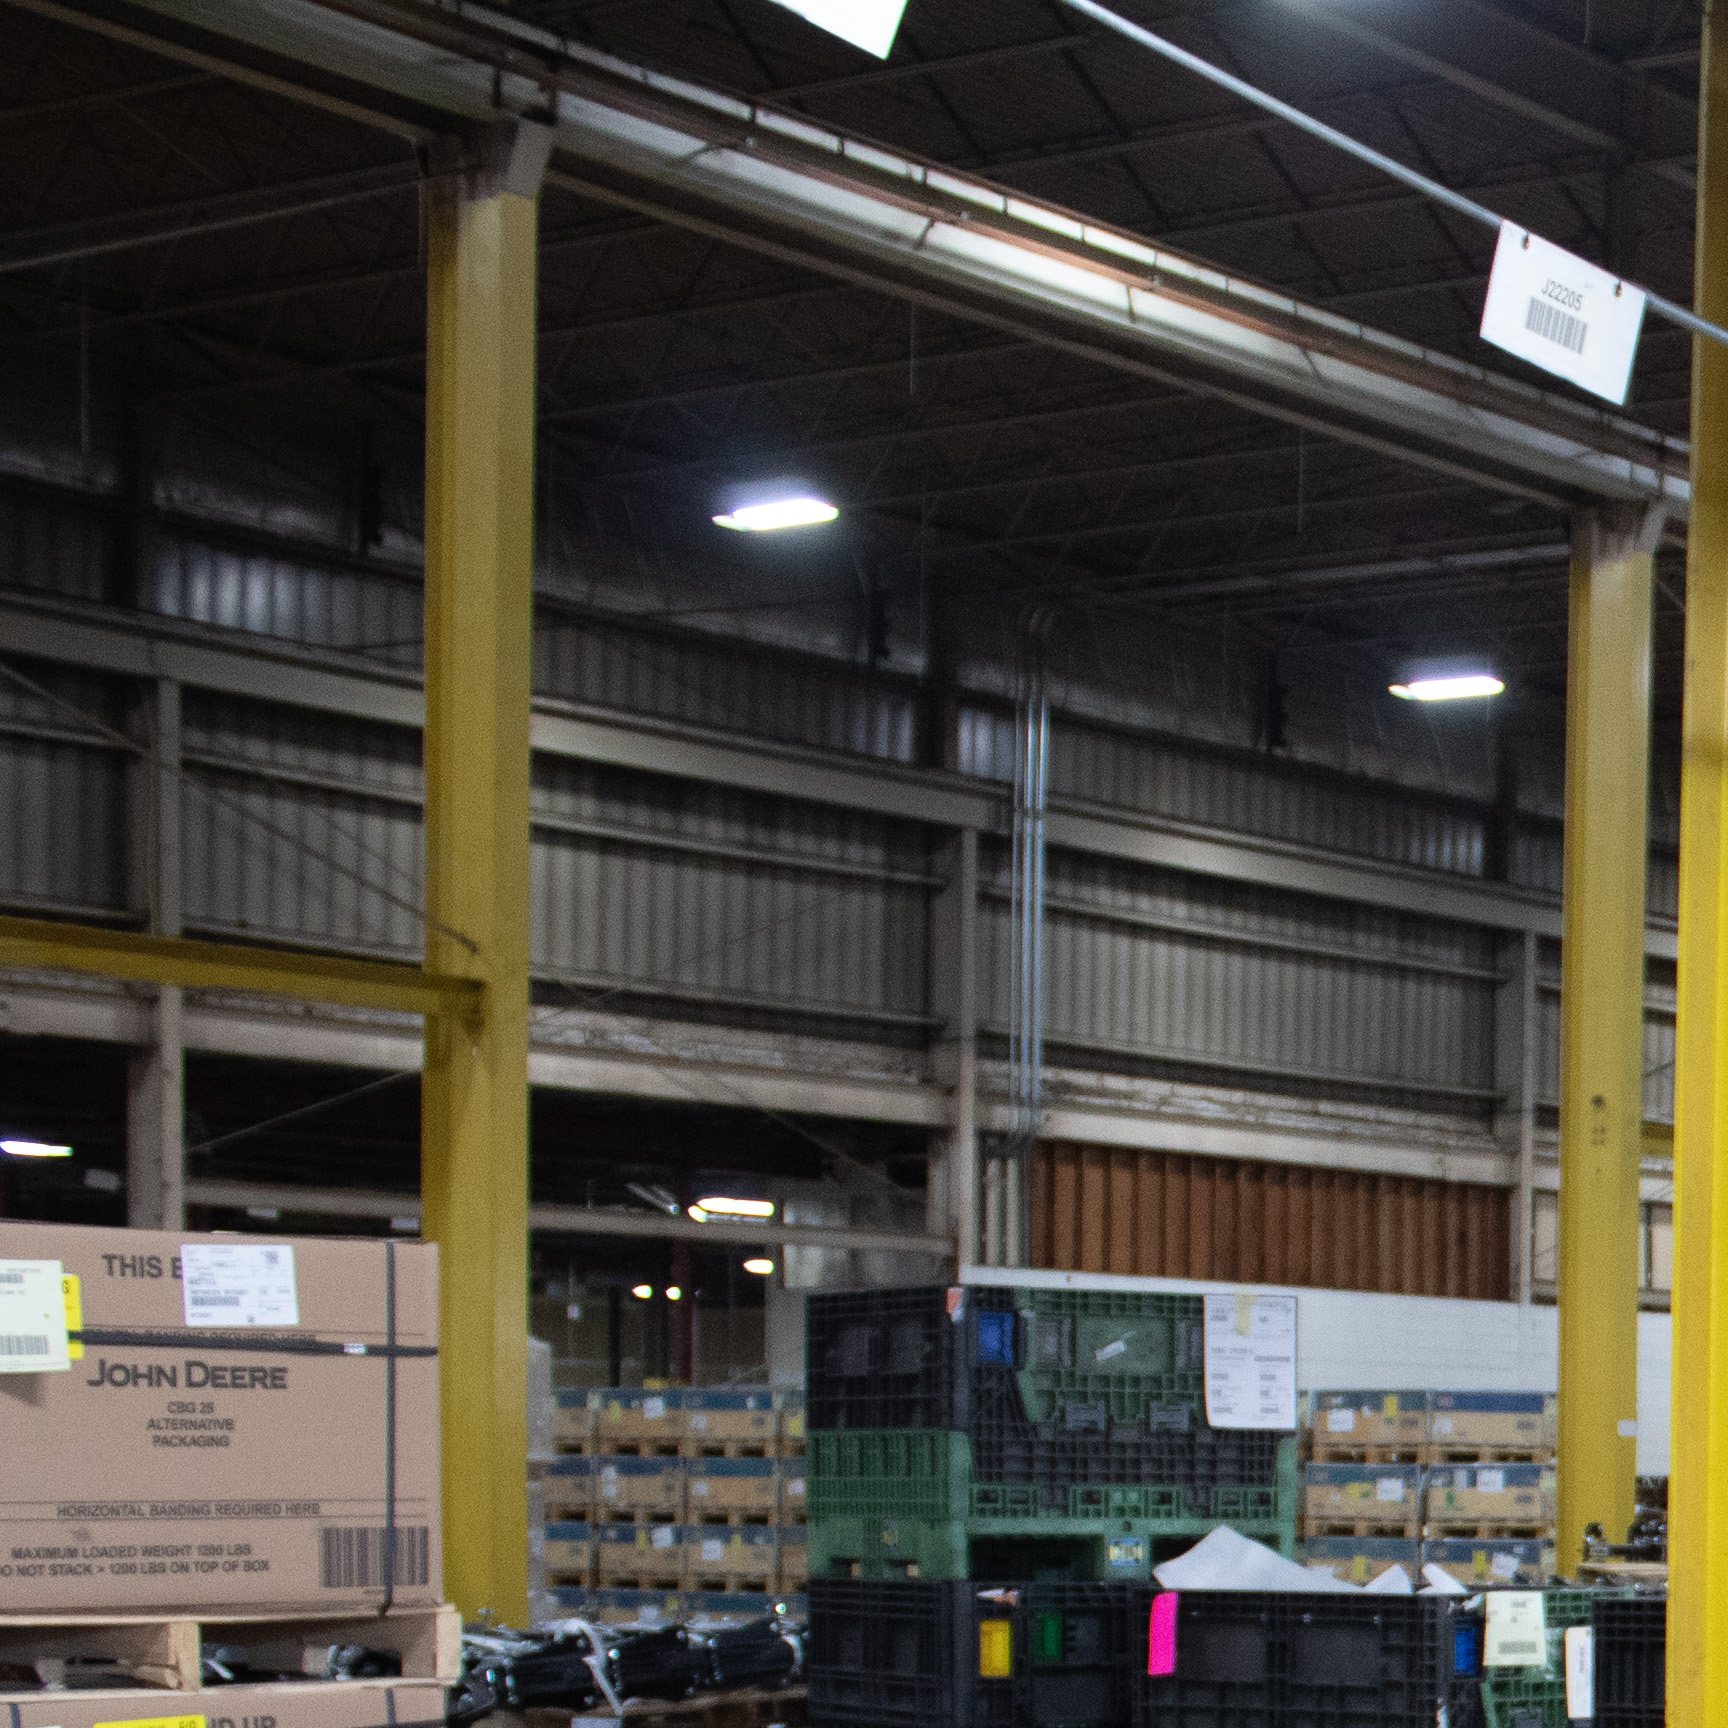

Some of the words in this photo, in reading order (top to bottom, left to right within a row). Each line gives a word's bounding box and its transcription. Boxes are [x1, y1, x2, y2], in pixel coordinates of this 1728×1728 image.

[1541, 278, 1583, 312] J22205
[101, 1254, 163, 1279] THIS
[87, 1358, 177, 1388] JOHN
[184, 1360, 288, 1390] DEERE
[167, 1402, 196, 1414] CBG
[146, 1418, 235, 1431] ALTERNATIVE
[152, 1435, 230, 1448] PACKAGING
[56, 1504, 146, 1518] HORIZONTAL
[150, 1503, 211, 1517] BANDING
[214, 1503, 282, 1517] REQUIRED
[285, 1503, 320, 1516] HERE
[11, 1546, 78, 1560] MAXIMUM
[82, 1545, 136, 1559] LOADED
[140, 1544, 192, 1558] WEIGHT
[227, 1543, 252, 1556] LBS
[17, 1564, 46, 1577] NOT
[50, 1563, 93, 1577] STACK
[140, 1562, 166, 1575] LBS
[170, 1561, 189, 1574] ON
[193, 1561, 219, 1574] TOP
[222, 1560, 240, 1573] OF
[244, 1559, 270, 1572] BOX
